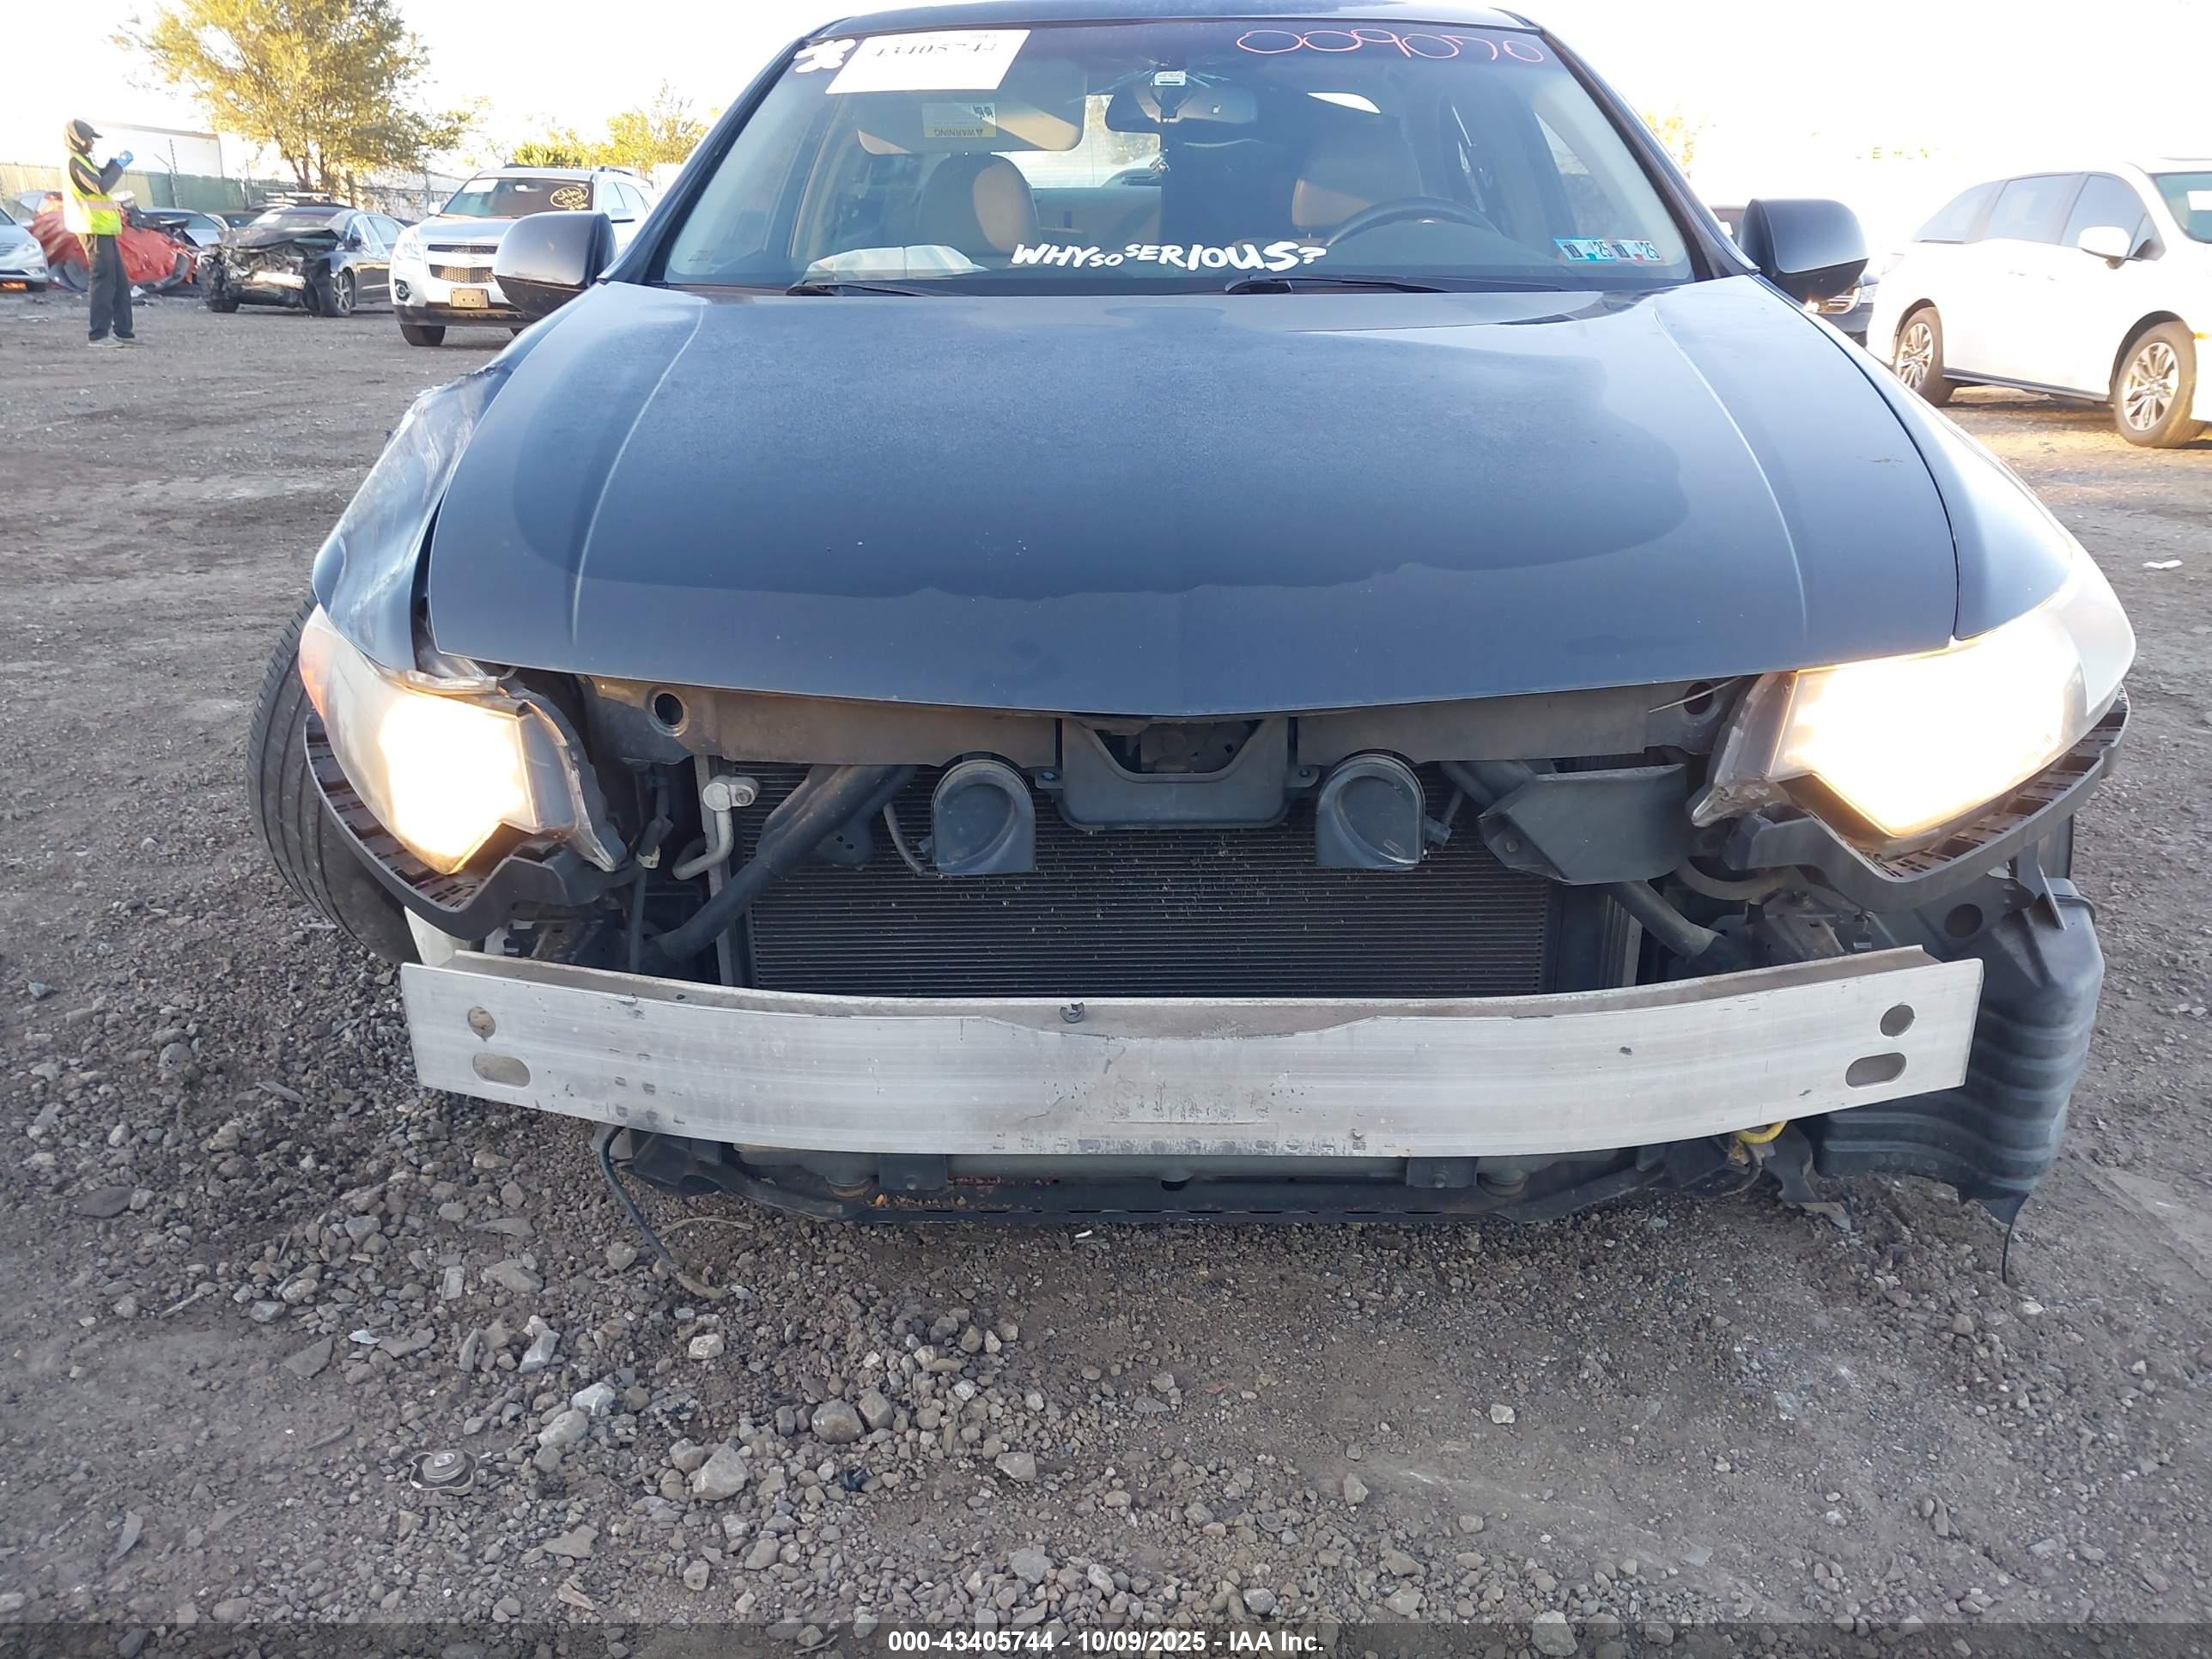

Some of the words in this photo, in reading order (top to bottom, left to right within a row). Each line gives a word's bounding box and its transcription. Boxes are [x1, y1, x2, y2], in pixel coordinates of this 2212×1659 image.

[1237, 28, 1544, 62] 009070
[1012, 244, 1101, 268] WHY
[1089, 253, 1124, 267] SO
[1125, 240, 1328, 271] SERIOUS?
